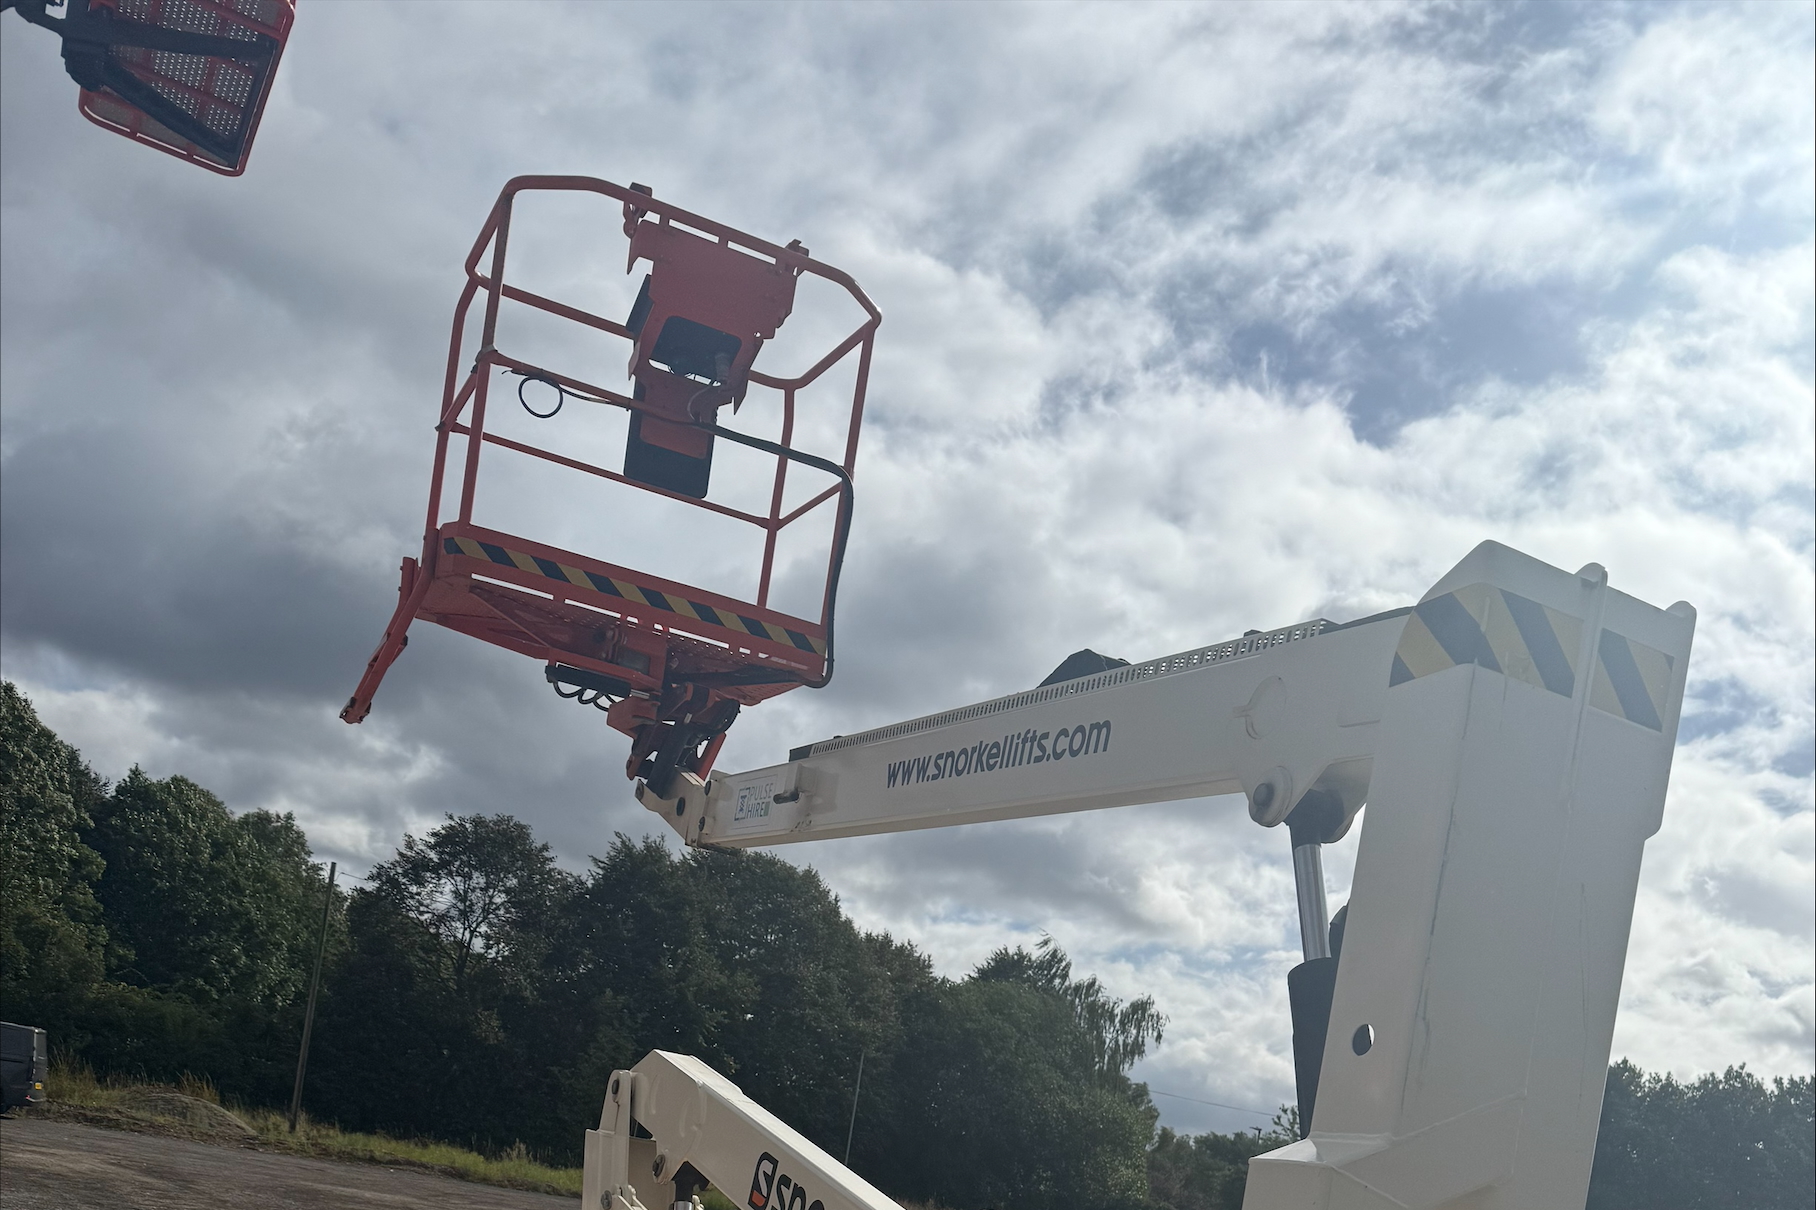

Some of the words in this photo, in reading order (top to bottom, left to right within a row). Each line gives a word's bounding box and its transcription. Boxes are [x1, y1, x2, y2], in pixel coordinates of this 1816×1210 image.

[887, 719, 1112, 789] www.snorkellifts.com
[750, 782, 774, 801] PULSE
[747, 801, 765, 819] HIRE
